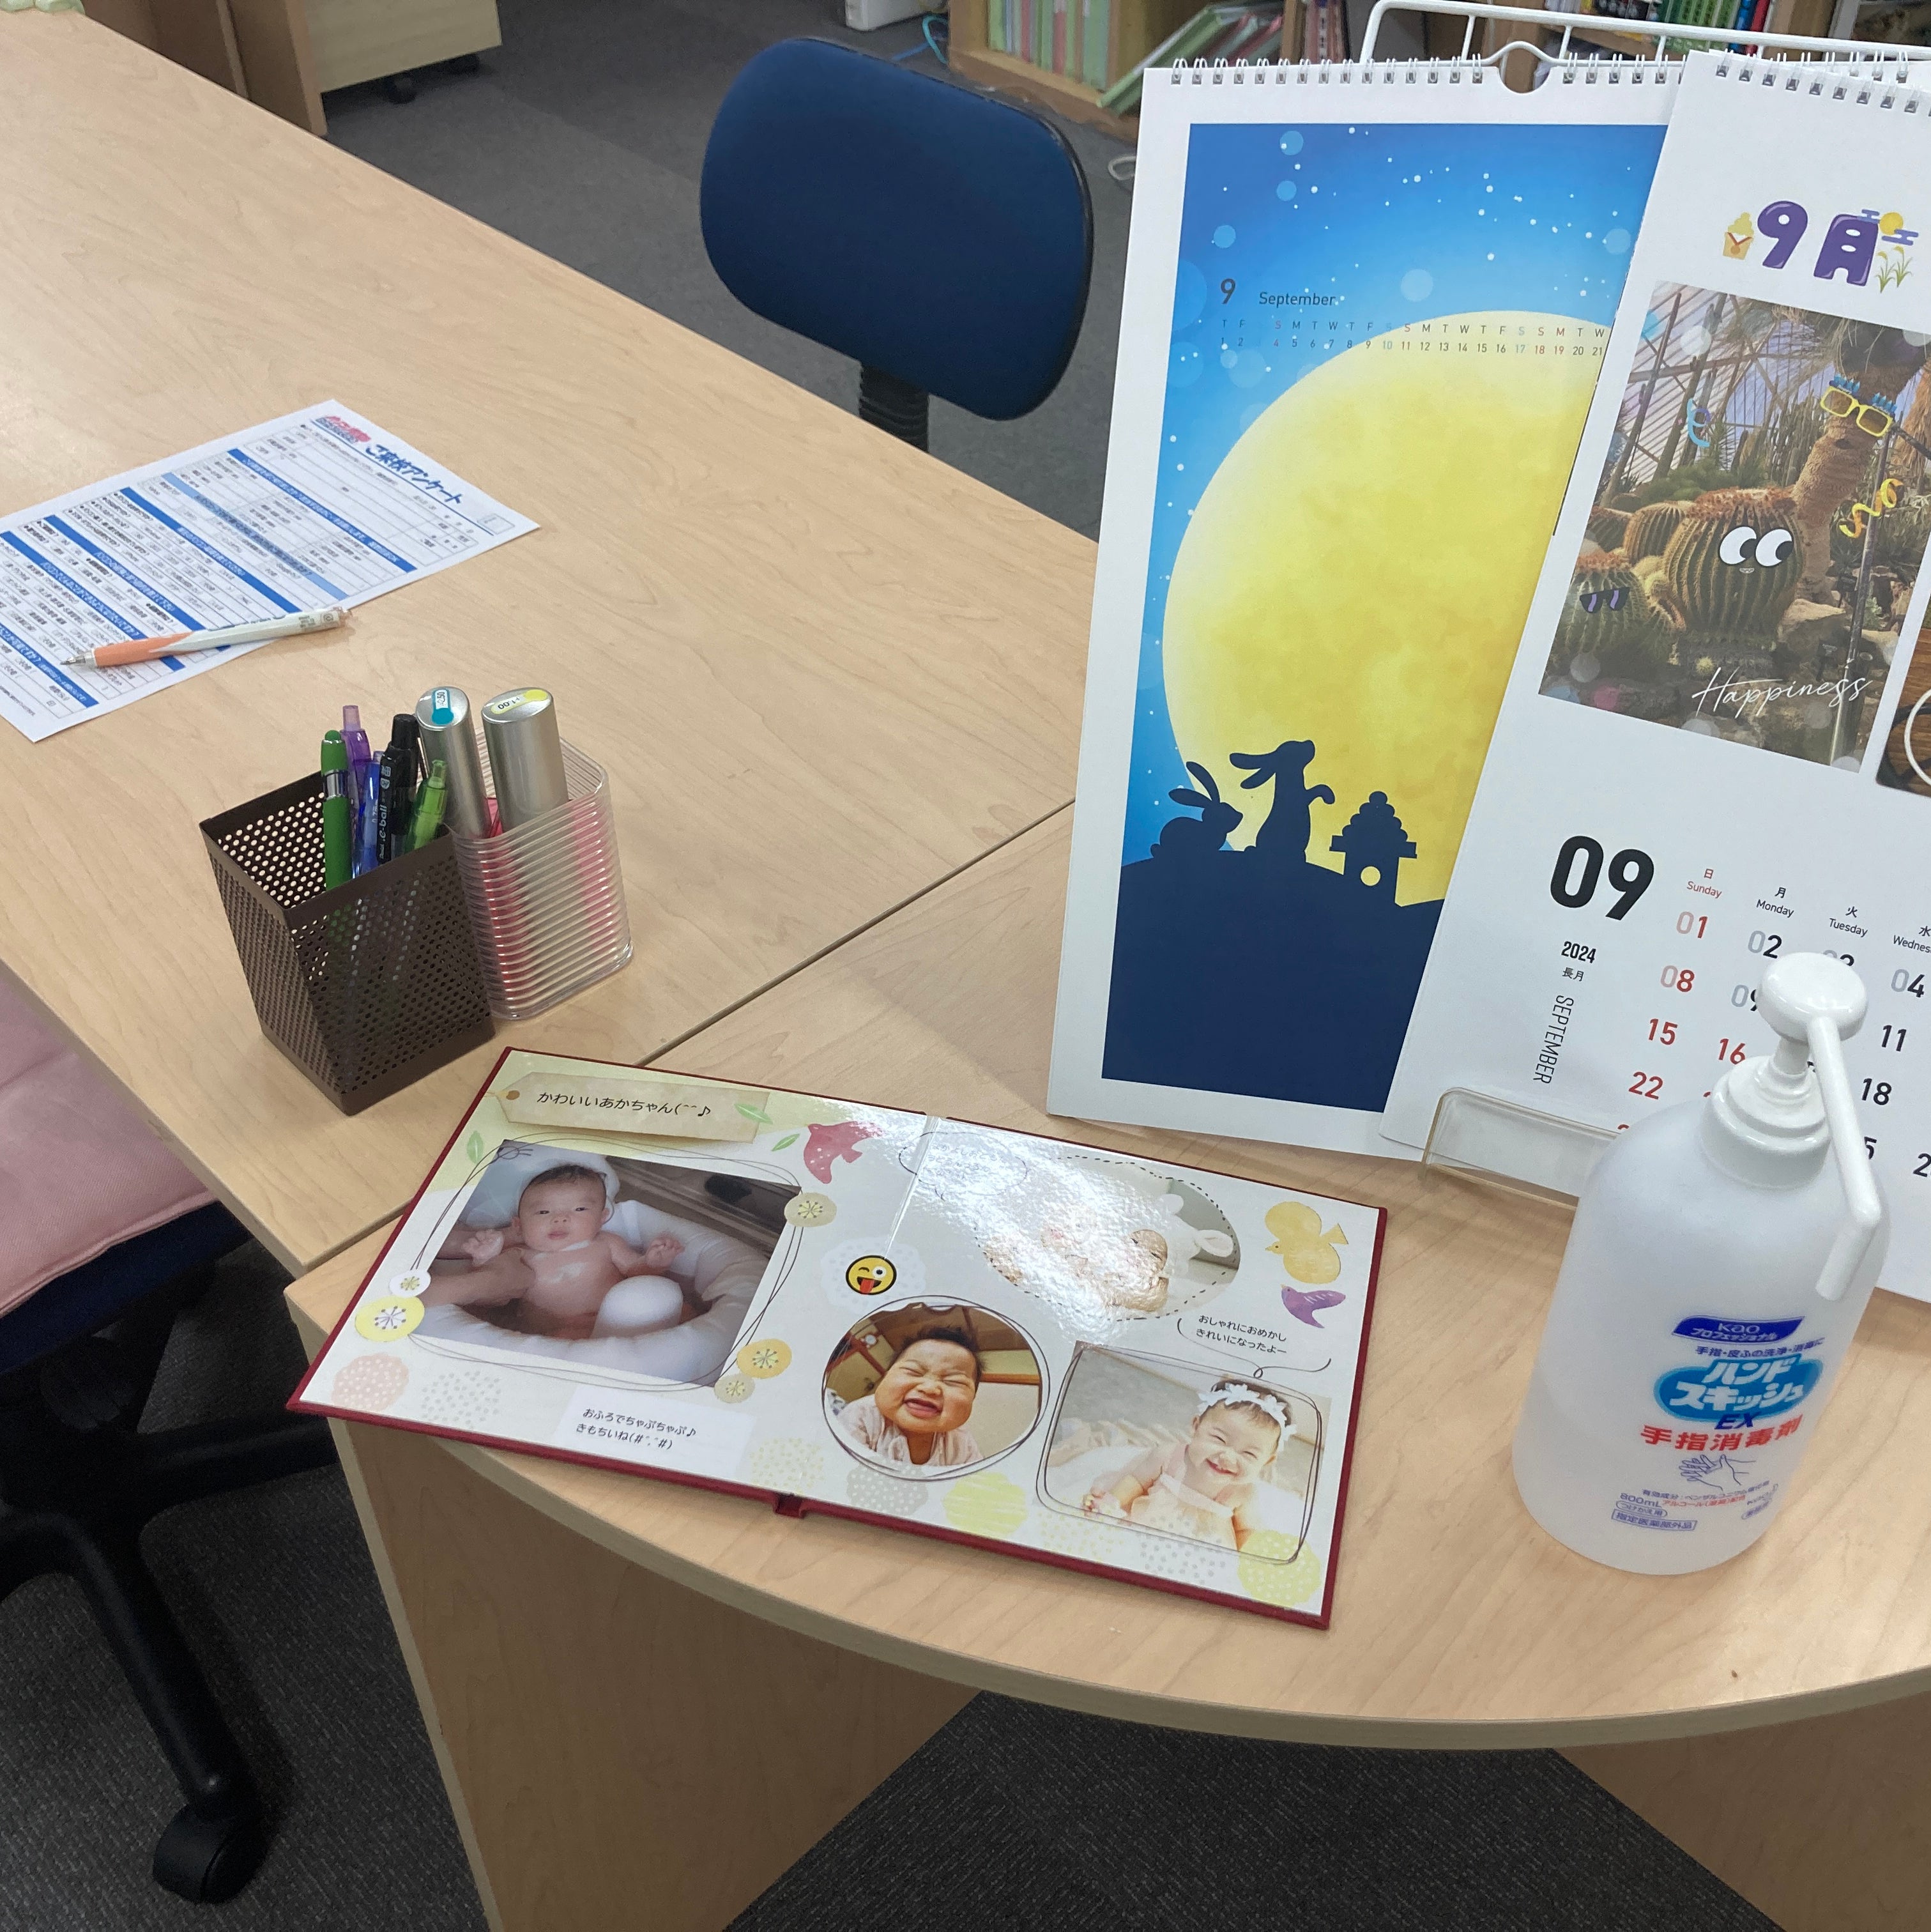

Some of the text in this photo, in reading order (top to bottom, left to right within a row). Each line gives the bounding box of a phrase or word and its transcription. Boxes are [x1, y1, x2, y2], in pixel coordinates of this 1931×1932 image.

[1220, 278, 1337, 308] 9 September
[1222, 319, 1228, 328] T
[1292, 321, 1301, 330] M
[1312, 321, 1318, 330] T
[1329, 321, 1338, 331] W
[1349, 322, 1355, 331] T
[1367, 322, 1373, 332] F
[1404, 323, 1411, 332] S
[1422, 323, 1431, 333] M
[1443, 324, 1449, 333] T
[1460, 325, 1469, 334] W
[1481, 325, 1487, 334] T
[1500, 326, 1506, 335] F
[1518, 326, 1525, 336] S
[1538, 326, 1545, 336] S
[1556, 327, 1565, 337] M
[1578, 328, 1584, 337] T
[1595, 328, 1605, 338] W
[1292, 339, 1297, 348] 5
[1310, 339, 1316, 348] 6
[1347, 340, 1353, 349] 8
[1366, 340, 1371, 349] 9
[1401, 341, 1410, 351] 11
[1420, 341, 1430, 351] 12
[1439, 342, 1449, 352] 13
[1458, 342, 1468, 352] 14
[1477, 343, 1487, 353] 15
[1497, 344, 1506, 353] 16
[1515, 344, 1525, 354] 17
[1535, 345, 1545, 355] 18
[1554, 345, 1564, 355] 19
[1573, 346, 1584, 356] 20
[1592, 346, 1603, 356] 21
[1691, 666, 1874, 719] Happiness
[1550, 835, 1654, 921] 09
[1704, 868, 1714, 879] 日
[1686, 880, 1723, 899] Sunday
[1774, 886, 1787, 898] 月
[1756, 899, 1794, 918] Monday
[1845, 906, 1858, 918] 火
[1829, 917, 1868, 938] Tuesday
[1918, 925, 1931, 937] 水
[1561, 940, 1597, 964] 2024
[1675, 910, 1925, 998] 01 02 04
[1893, 934, 1931, 954] Wednes
[1562, 966, 1585, 982] 長月
[1660, 965, 1696, 993] 08
[1881, 1024, 1907, 1052] 11
[1532, 994, 1575, 1084] SEPTEMBER
[1647, 1018, 1892, 1106] 15 16 18
[1628, 1071, 1877, 1160] 22 5
[1913, 1153, 1931, 1178] 2
[1198, 1314, 1287, 1342] おしゃれにおめかし
[1196, 1328, 1287, 1354] きれいになったよー
[1701, 1355, 1798, 1386] ハンド
[1669, 1381, 1805, 1411] スキッシュ
[1640, 1413, 1804, 1452] 手指消毒剤
[1714, 1411, 1763, 1430] EX
